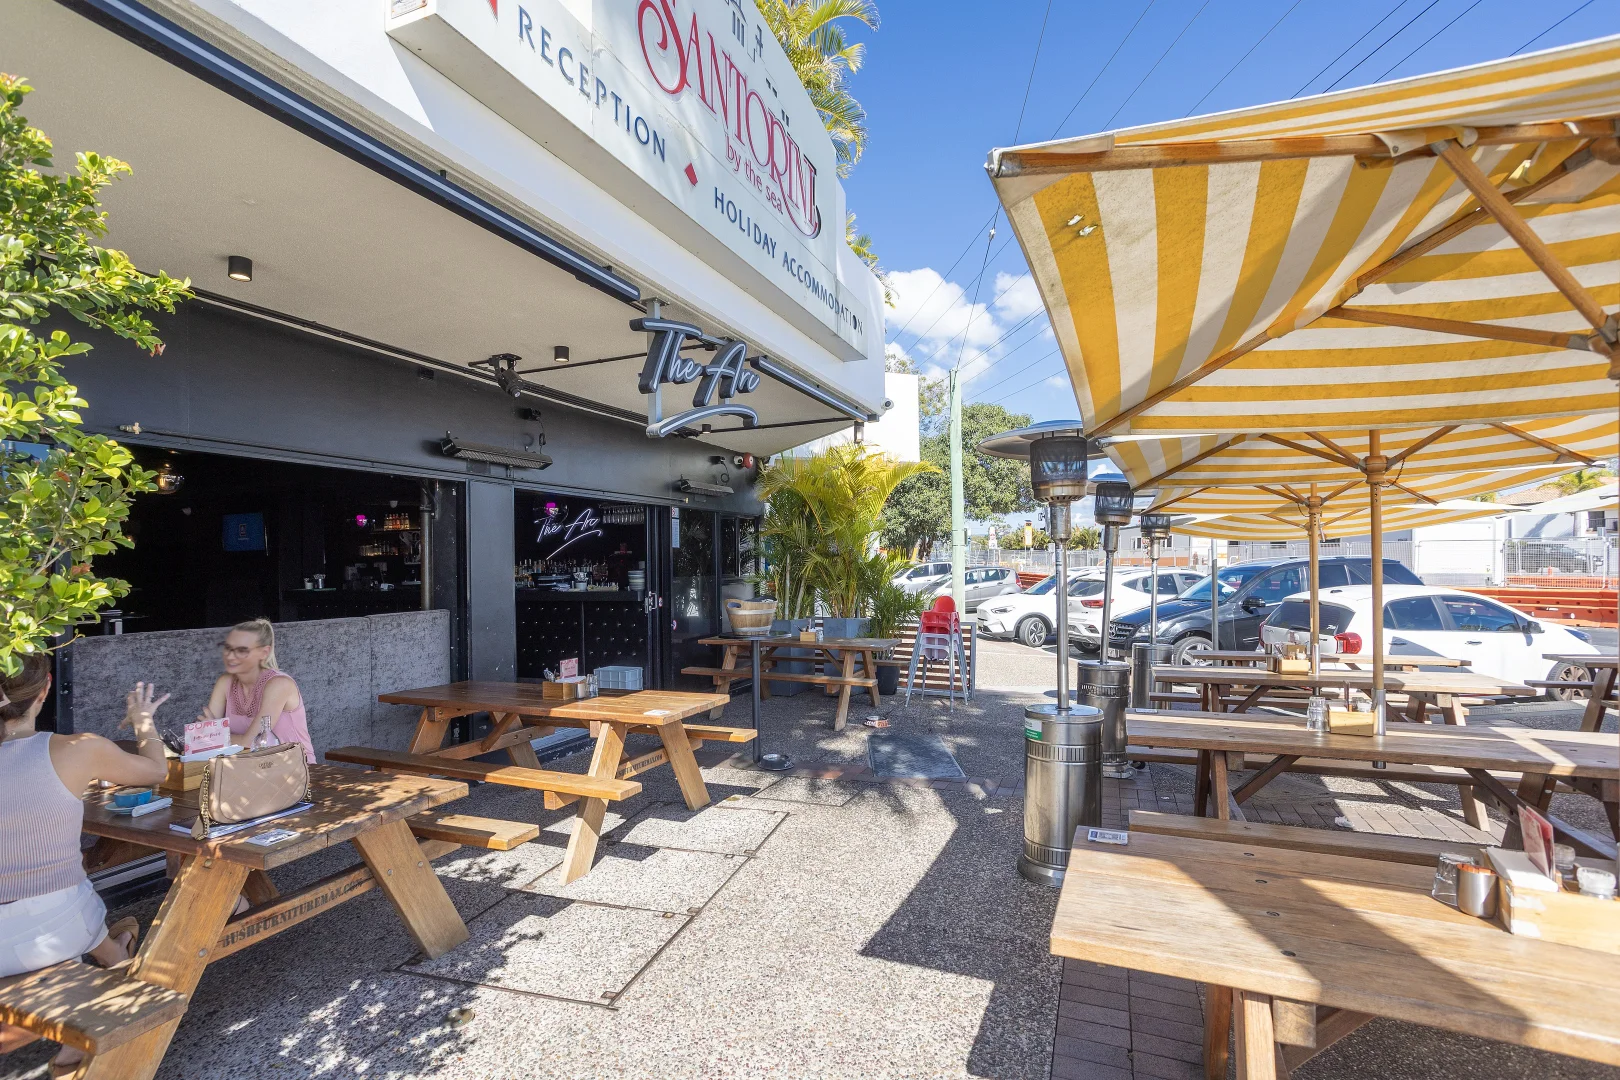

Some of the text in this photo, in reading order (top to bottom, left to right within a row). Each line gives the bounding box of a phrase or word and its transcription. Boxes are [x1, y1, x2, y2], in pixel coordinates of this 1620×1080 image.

[518, 5, 665, 163] RECEPTION
[637, 0, 820, 238] SANTORINI
[726, 134, 784, 215] by the sea
[714, 186, 863, 336] HOLIDAY ACCOMMODATION
[629, 317, 761, 407] The Arc
[534, 508, 600, 543] The Arc
